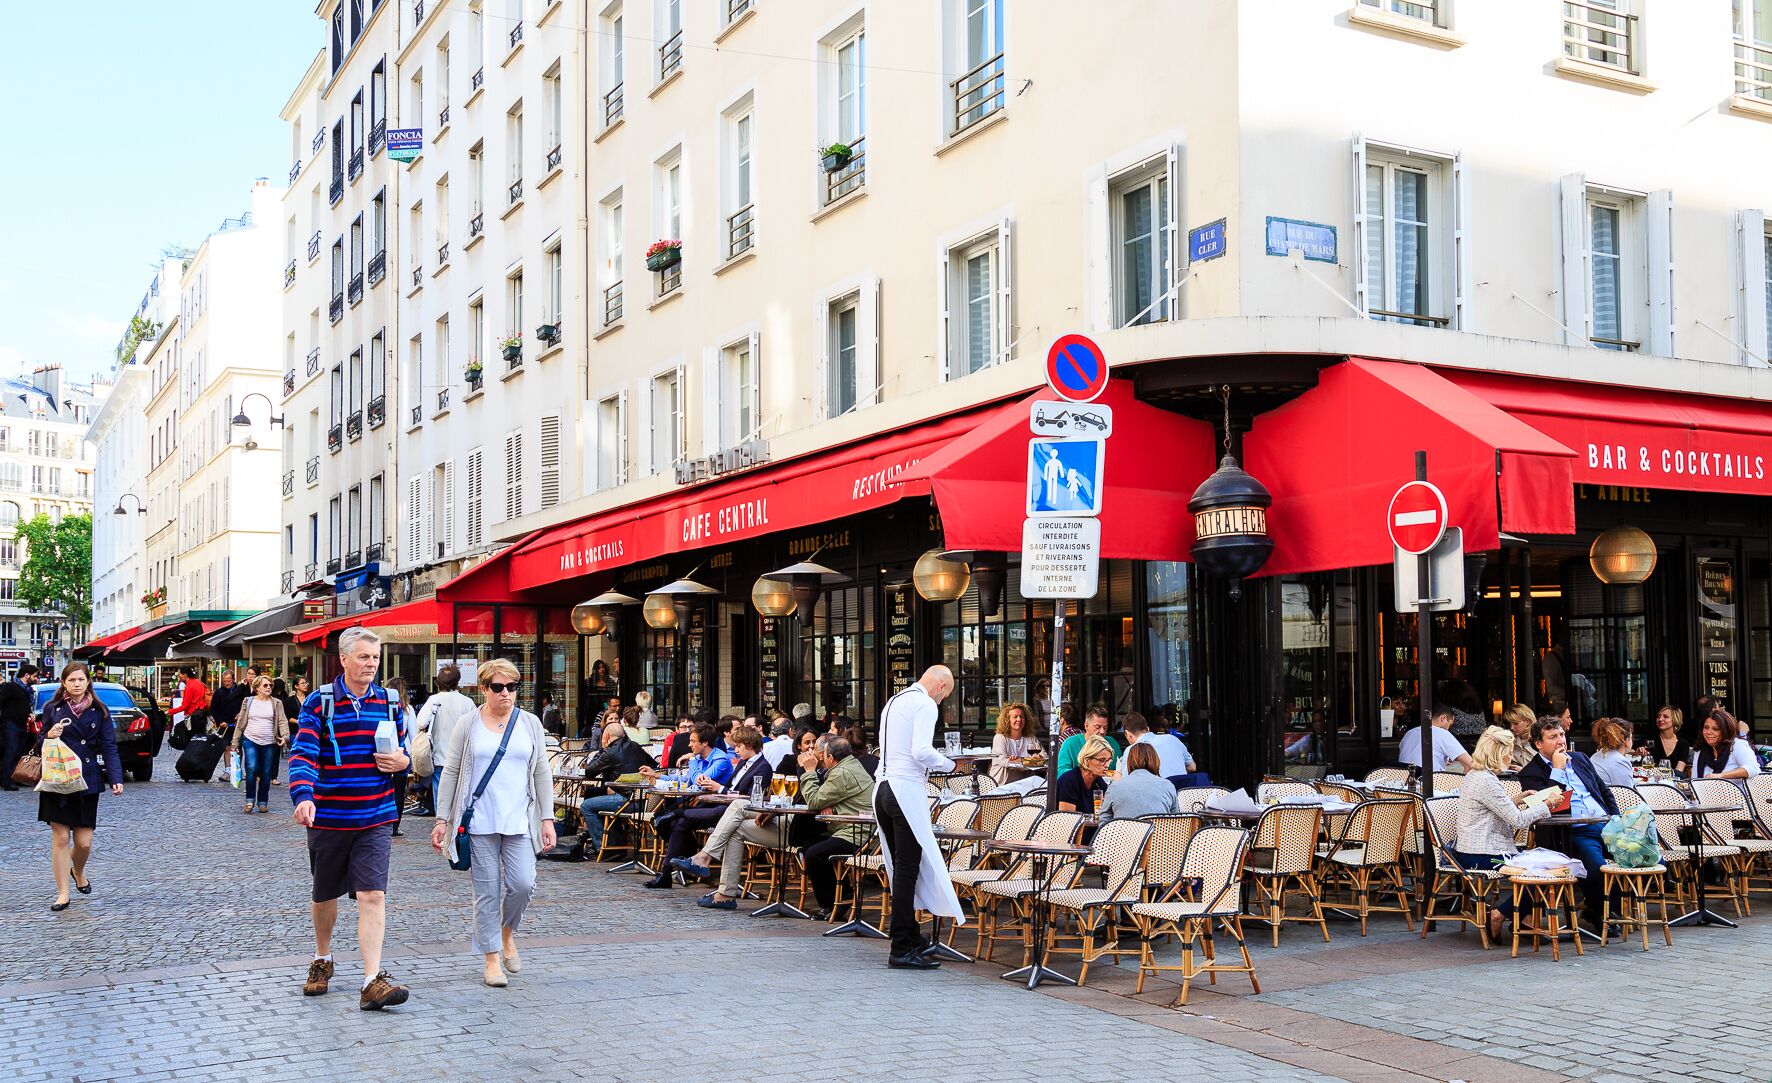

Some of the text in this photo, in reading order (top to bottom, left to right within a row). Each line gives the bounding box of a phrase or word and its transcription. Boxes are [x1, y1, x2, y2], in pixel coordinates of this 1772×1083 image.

[388, 131, 422, 140] FONCIA
[1200, 228, 1216, 243] RUE
[1288, 228, 1317, 241] RUE DU
[1198, 241, 1217, 256] CLER
[1299, 241, 1310, 252] DE
[1312, 243, 1334, 255] MARS
[1587, 443, 1765, 480] BAR & COCKTAILS
[683, 497, 769, 543] CAFE CENTRAL
[789, 536, 821, 556] GRANDE
[560, 540, 624, 571] BAR & COCKTAILS
[1709, 662, 1728, 673] VINS
